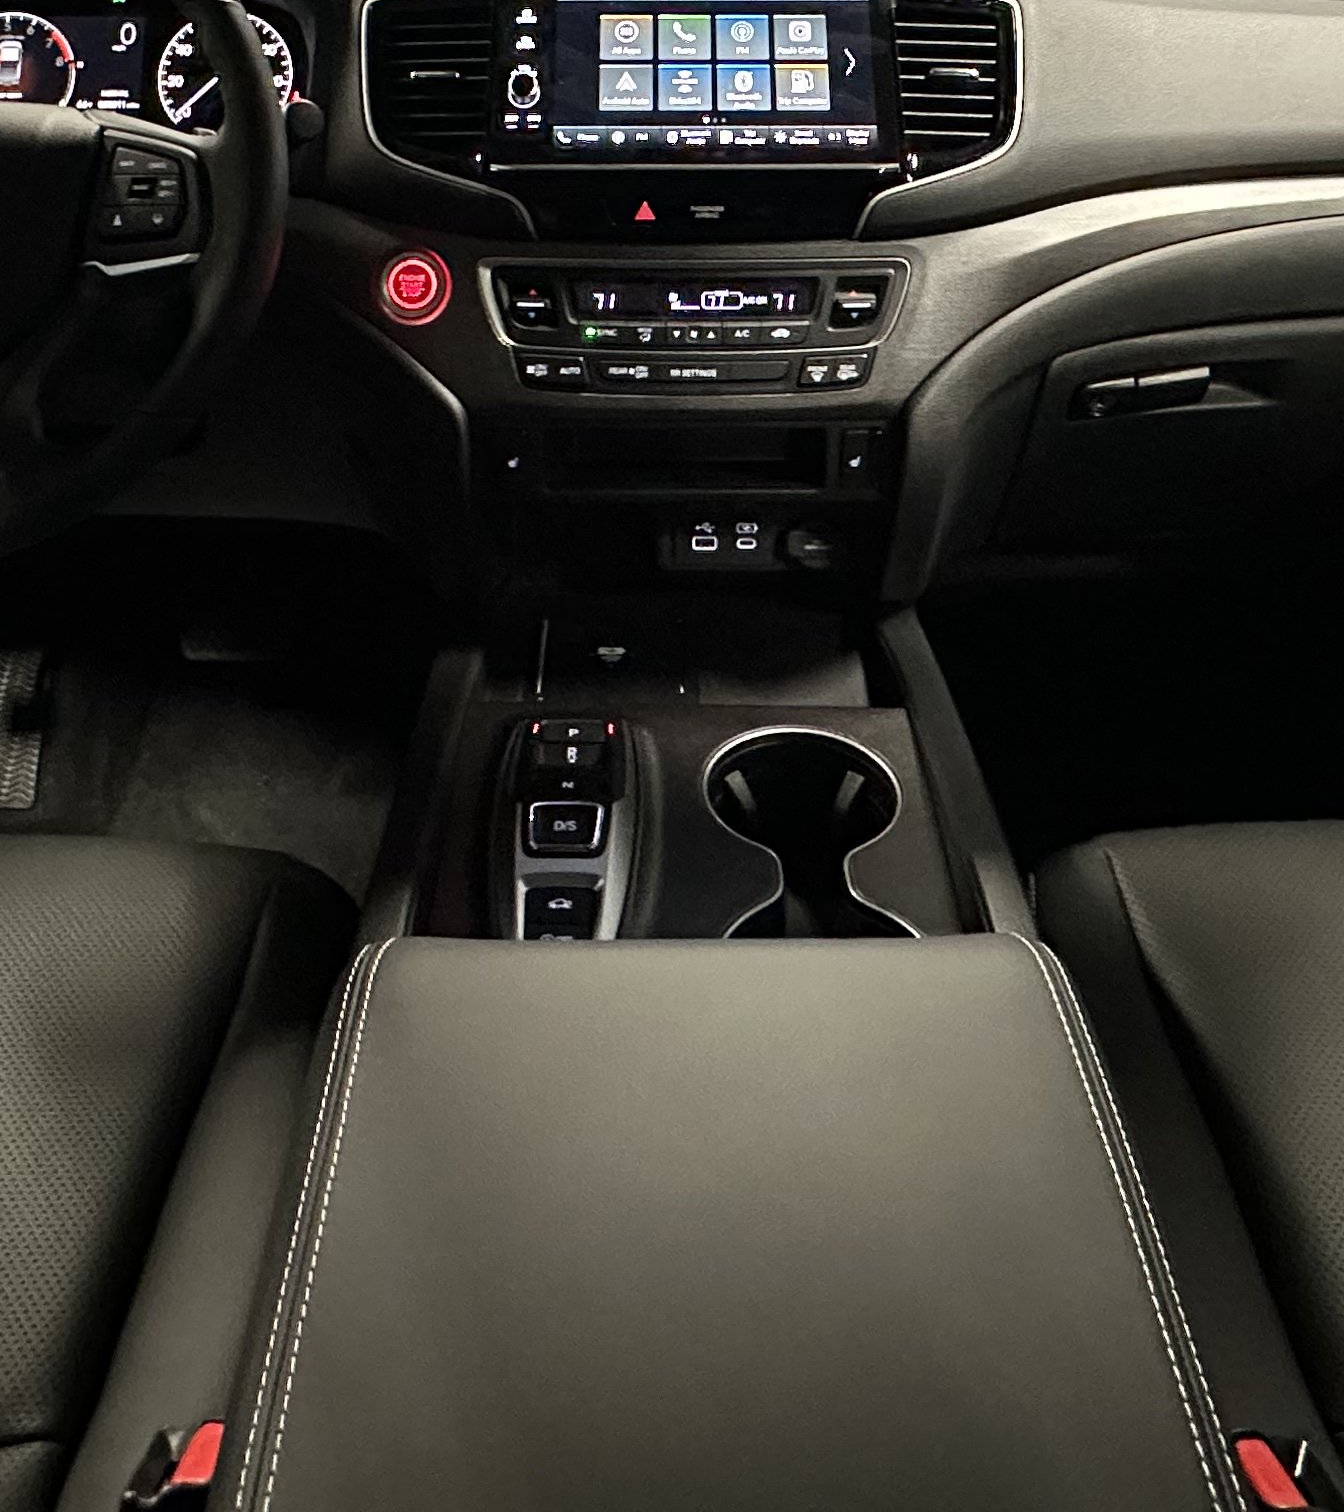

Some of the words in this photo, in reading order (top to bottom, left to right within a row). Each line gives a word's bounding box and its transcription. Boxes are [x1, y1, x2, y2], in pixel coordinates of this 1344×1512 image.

[120, 22, 136, 45] 0
[593, 293, 616, 310] 71
[773, 293, 795, 310] 71
[567, 728, 580, 737] P
[561, 780, 576, 789] N
